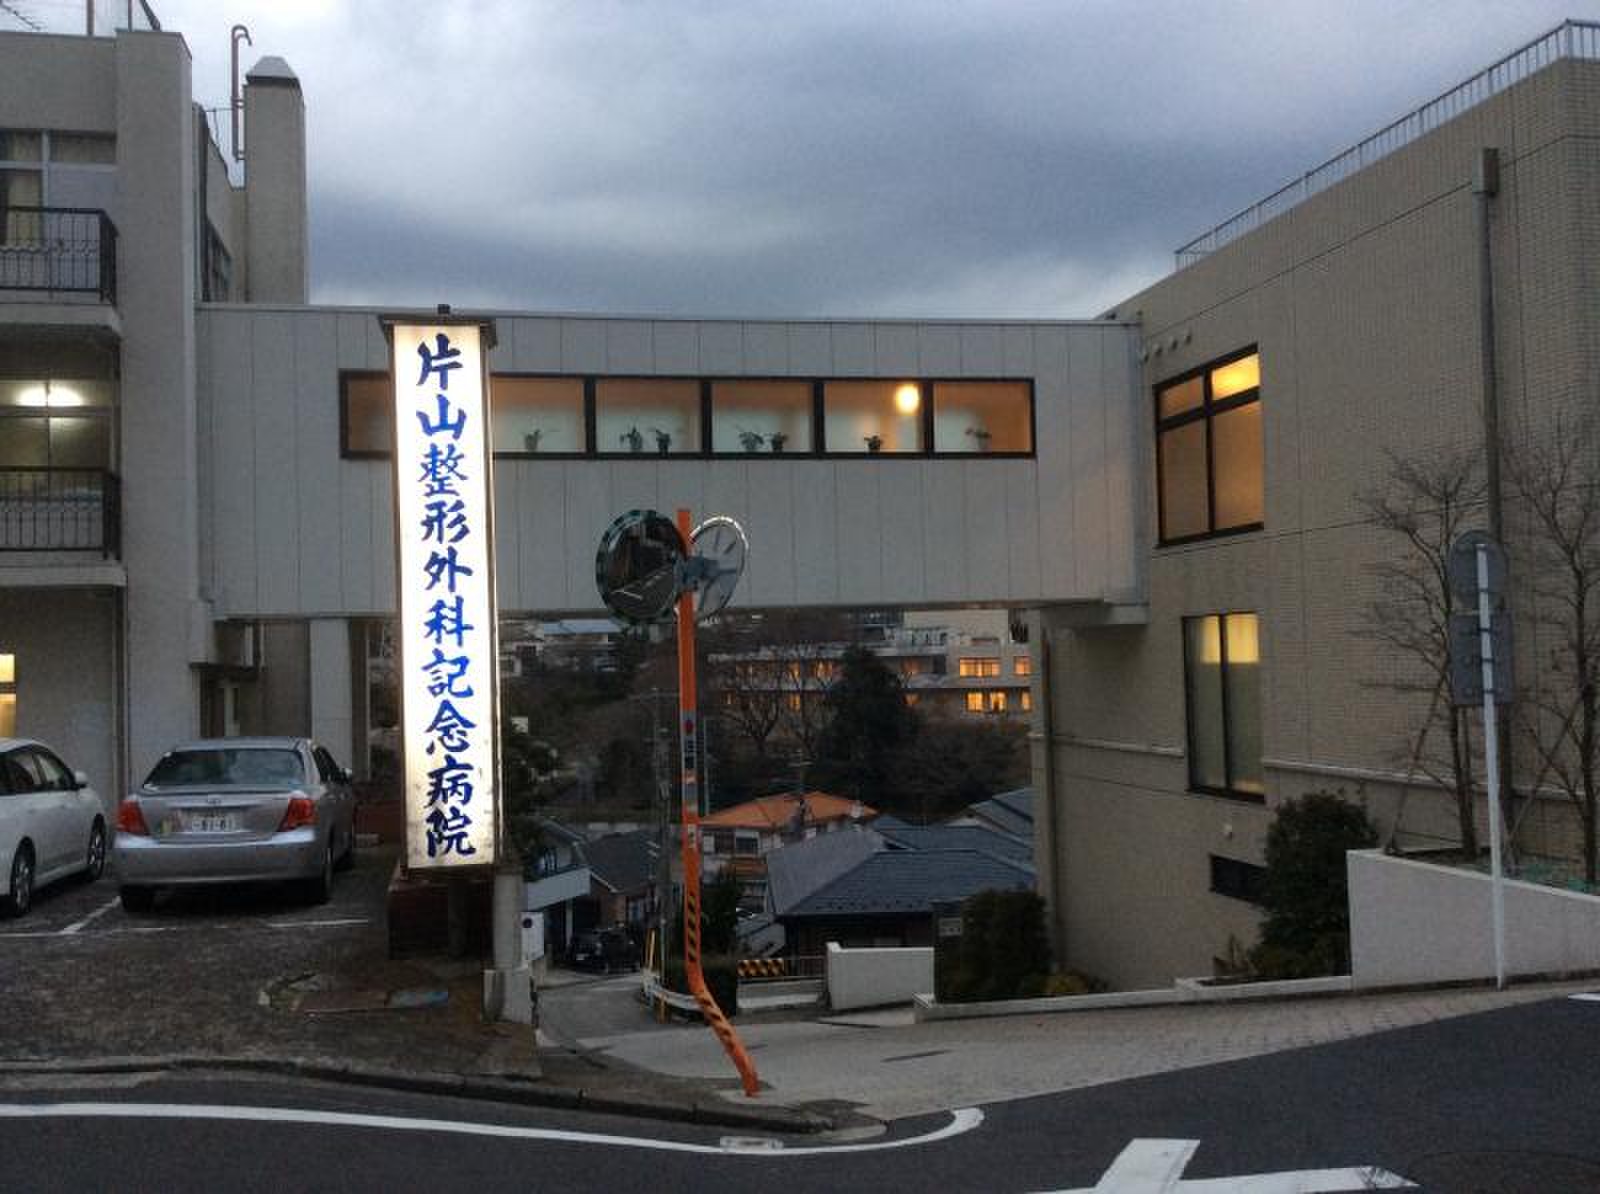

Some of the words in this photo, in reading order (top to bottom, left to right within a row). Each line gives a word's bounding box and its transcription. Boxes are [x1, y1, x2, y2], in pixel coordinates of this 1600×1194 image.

[416, 333, 477, 858] 片山整形外科記念病院
